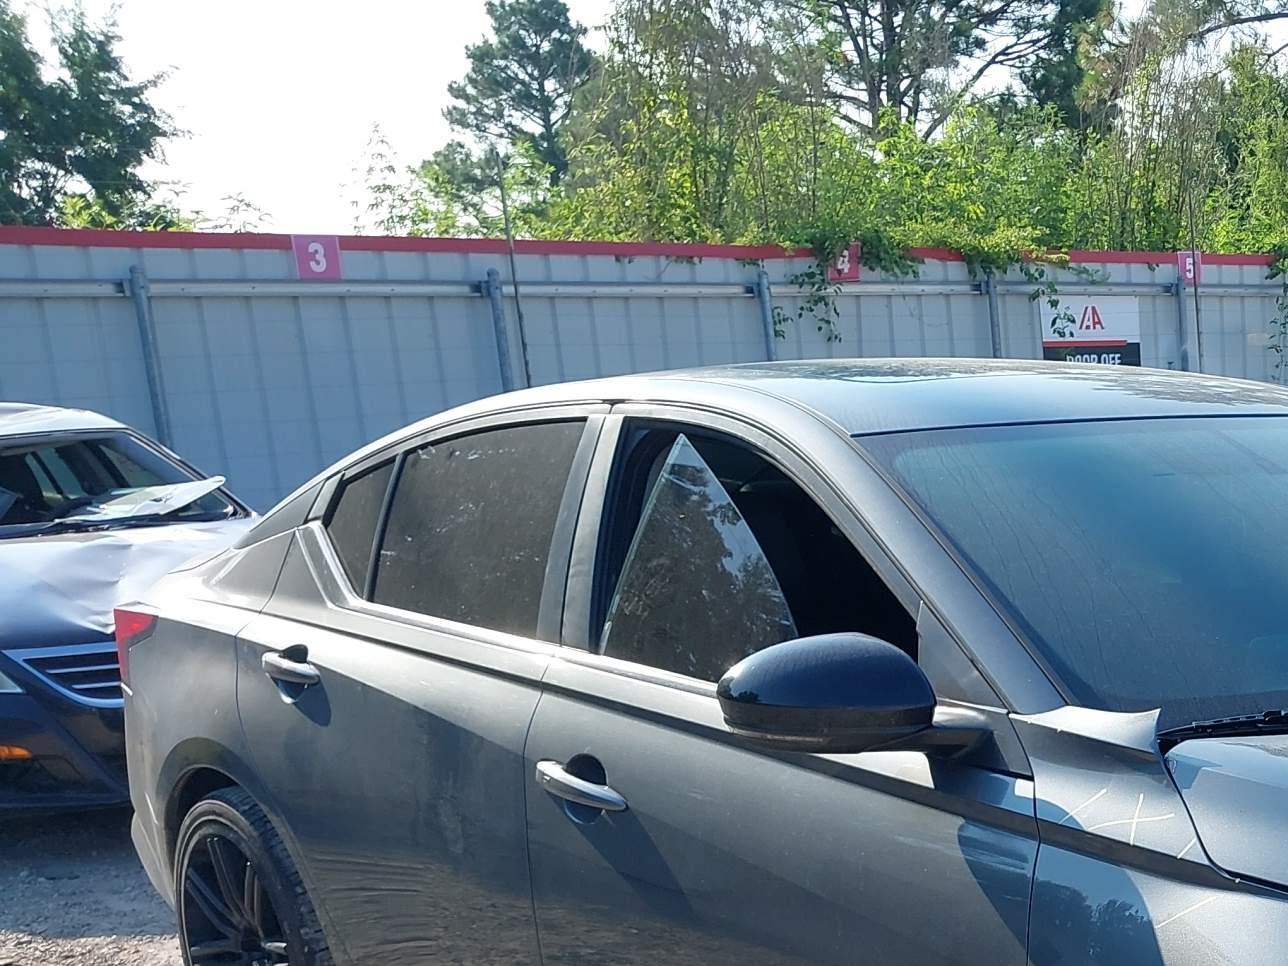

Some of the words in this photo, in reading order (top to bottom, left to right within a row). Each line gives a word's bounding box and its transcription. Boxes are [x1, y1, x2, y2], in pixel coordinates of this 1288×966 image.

[308, 242, 327, 273] 3
[837, 249, 850, 273] 4
[1185, 257, 1194, 279] 5
